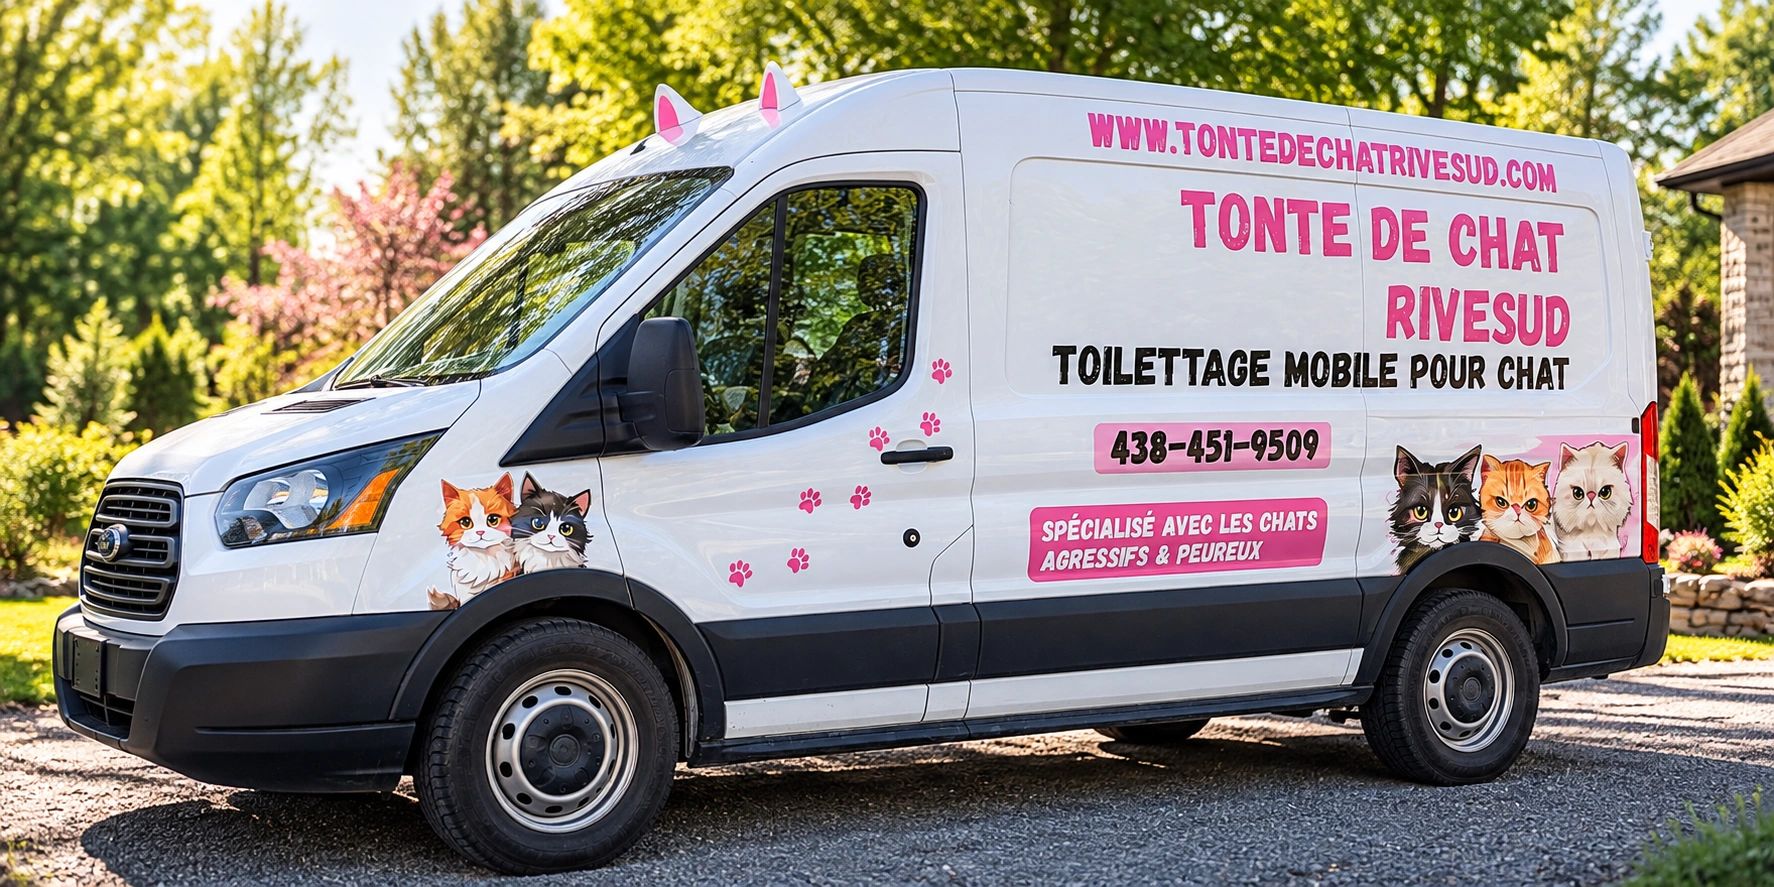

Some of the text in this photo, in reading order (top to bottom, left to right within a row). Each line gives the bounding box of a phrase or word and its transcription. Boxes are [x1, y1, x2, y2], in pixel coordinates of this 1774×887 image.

[1087, 112, 1557, 193] WWW.TONTEDECHATRIVESUD.COM
[1180, 190, 1565, 273] TONTE DE CHAT
[1386, 285, 1571, 348] RIVESUD
[1052, 346, 1570, 390] TOILETTAGE MOBILE POUR CHAT
[1110, 429, 1319, 465] 438-451-9509
[1041, 511, 1318, 543] SPÉCIALISÉ AVEC LES CHATS
[1040, 541, 1264, 572] AGRESSIFS & PEUREUX
